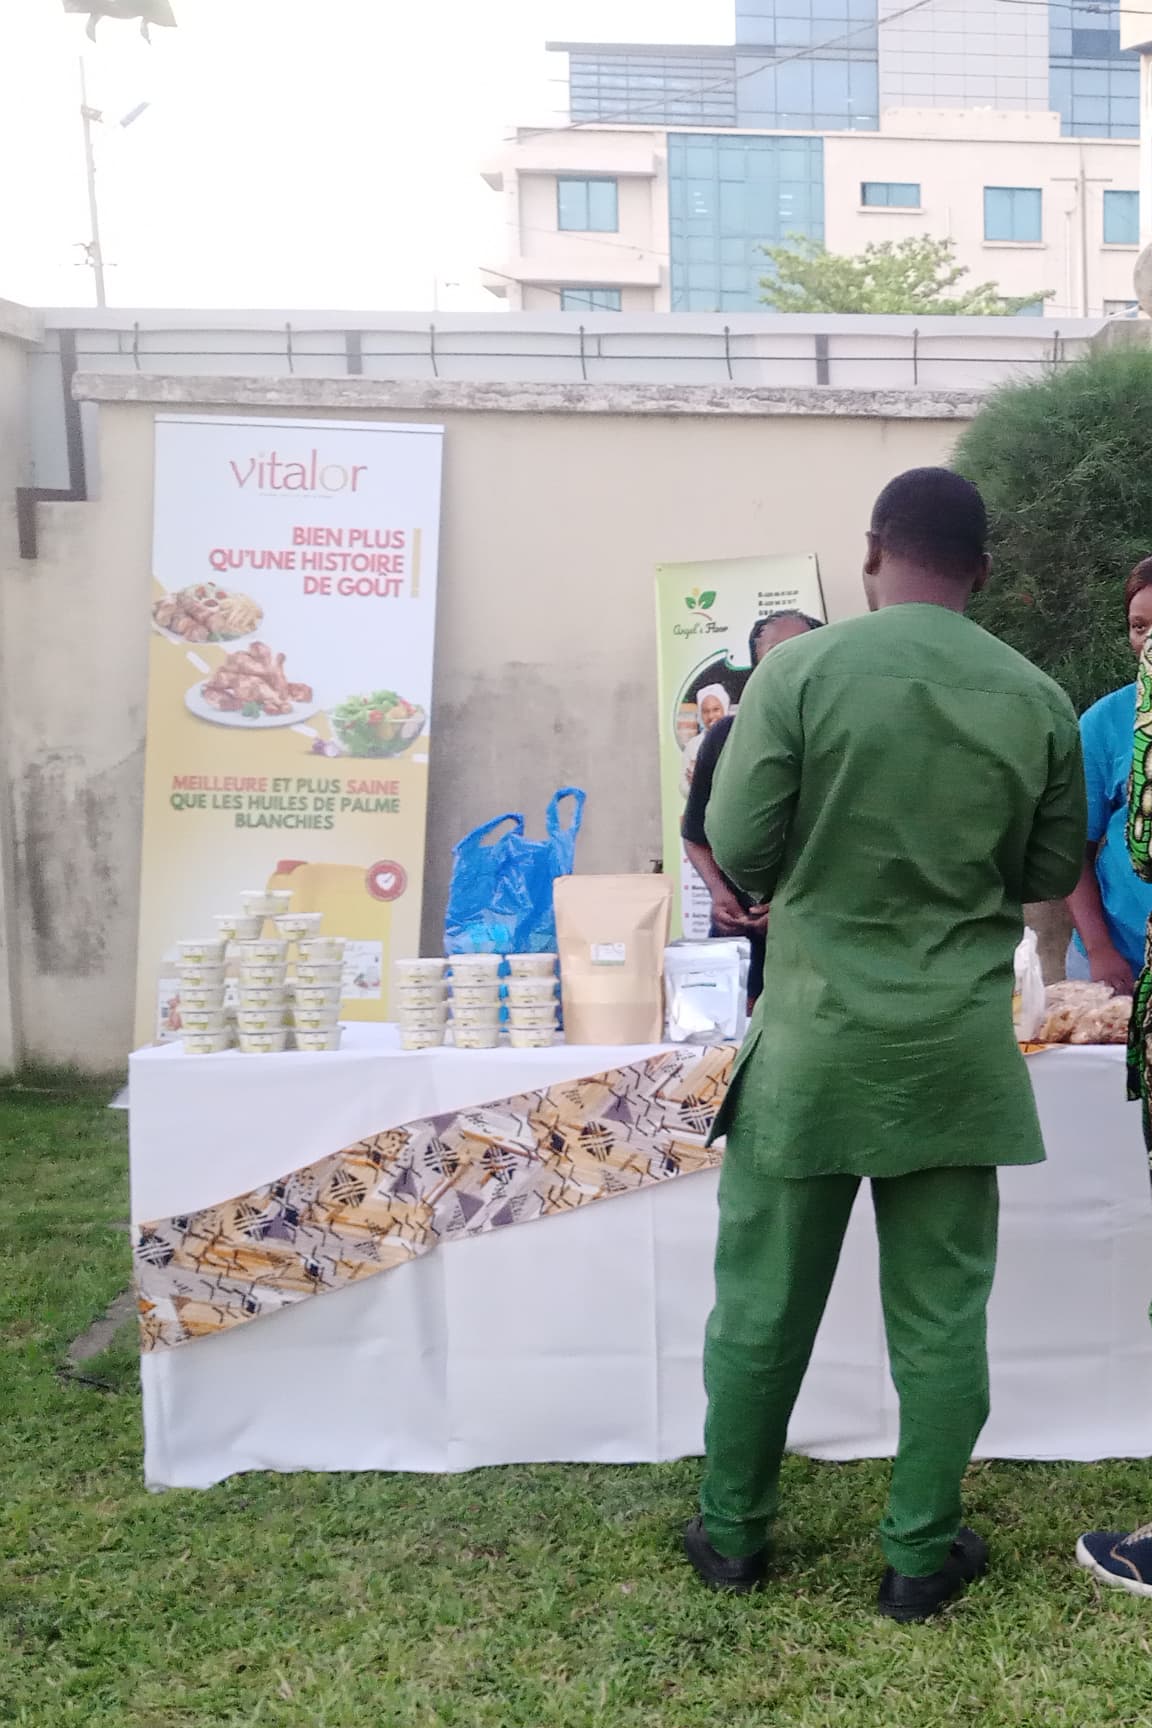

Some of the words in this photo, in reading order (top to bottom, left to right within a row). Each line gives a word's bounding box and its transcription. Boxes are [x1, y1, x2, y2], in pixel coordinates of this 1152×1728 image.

[229, 448, 368, 493] vitalor
[292, 526, 343, 547] BIEN
[349, 528, 405, 549] PLUS
[209, 548, 296, 572] QU'UNE
[301, 551, 404, 573] HISTOIRE
[304, 575, 331, 596] DE
[337, 571, 403, 598] GOÛT
[172, 775, 268, 793] MEILLEURE
[272, 778, 291, 793] ET
[296, 779, 340, 794] PLUS
[346, 780, 400, 795] SAINE
[170, 793, 206, 811] QUE
[212, 794, 243, 809] LES
[248, 795, 308, 811] HUILES
[314, 796, 335, 812] DE
[340, 797, 401, 814] PALME
[235, 813, 335, 830] BLANCHIES
